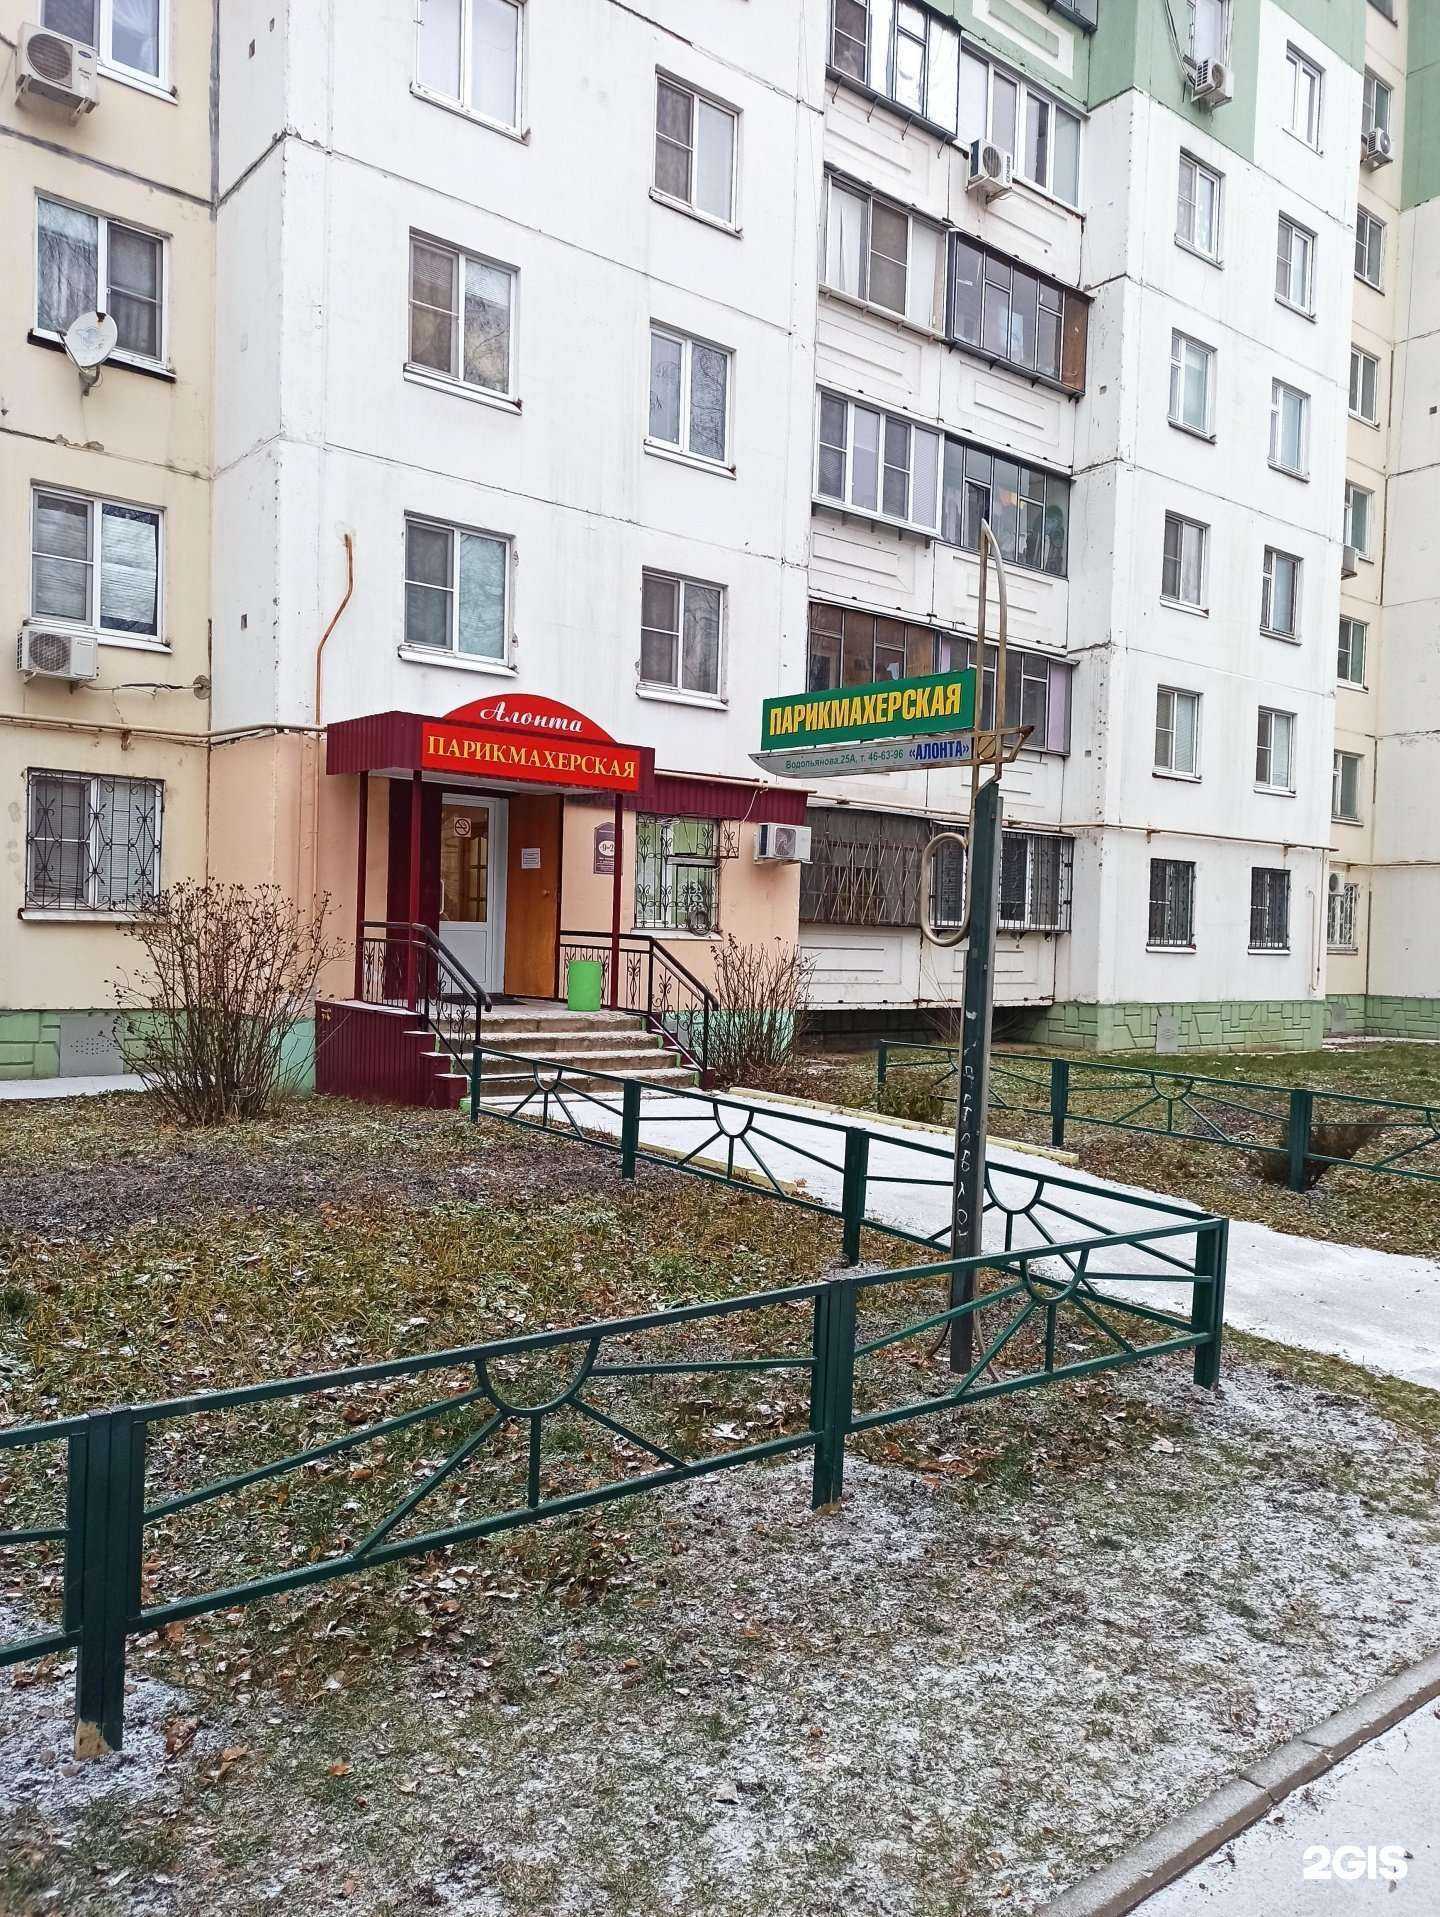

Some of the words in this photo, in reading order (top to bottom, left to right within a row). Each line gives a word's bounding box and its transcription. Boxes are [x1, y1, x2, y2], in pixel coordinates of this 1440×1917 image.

[479, 701, 584, 733] Алонта
[769, 683, 962, 736] ПАРИКМАХЕРСКАЯ
[427, 735, 637, 778] ПАРИКМАХЕРСКАЯ
[868, 749, 904, 762] 46-63-96
[909, 740, 970, 760] «АЛОНТА»
